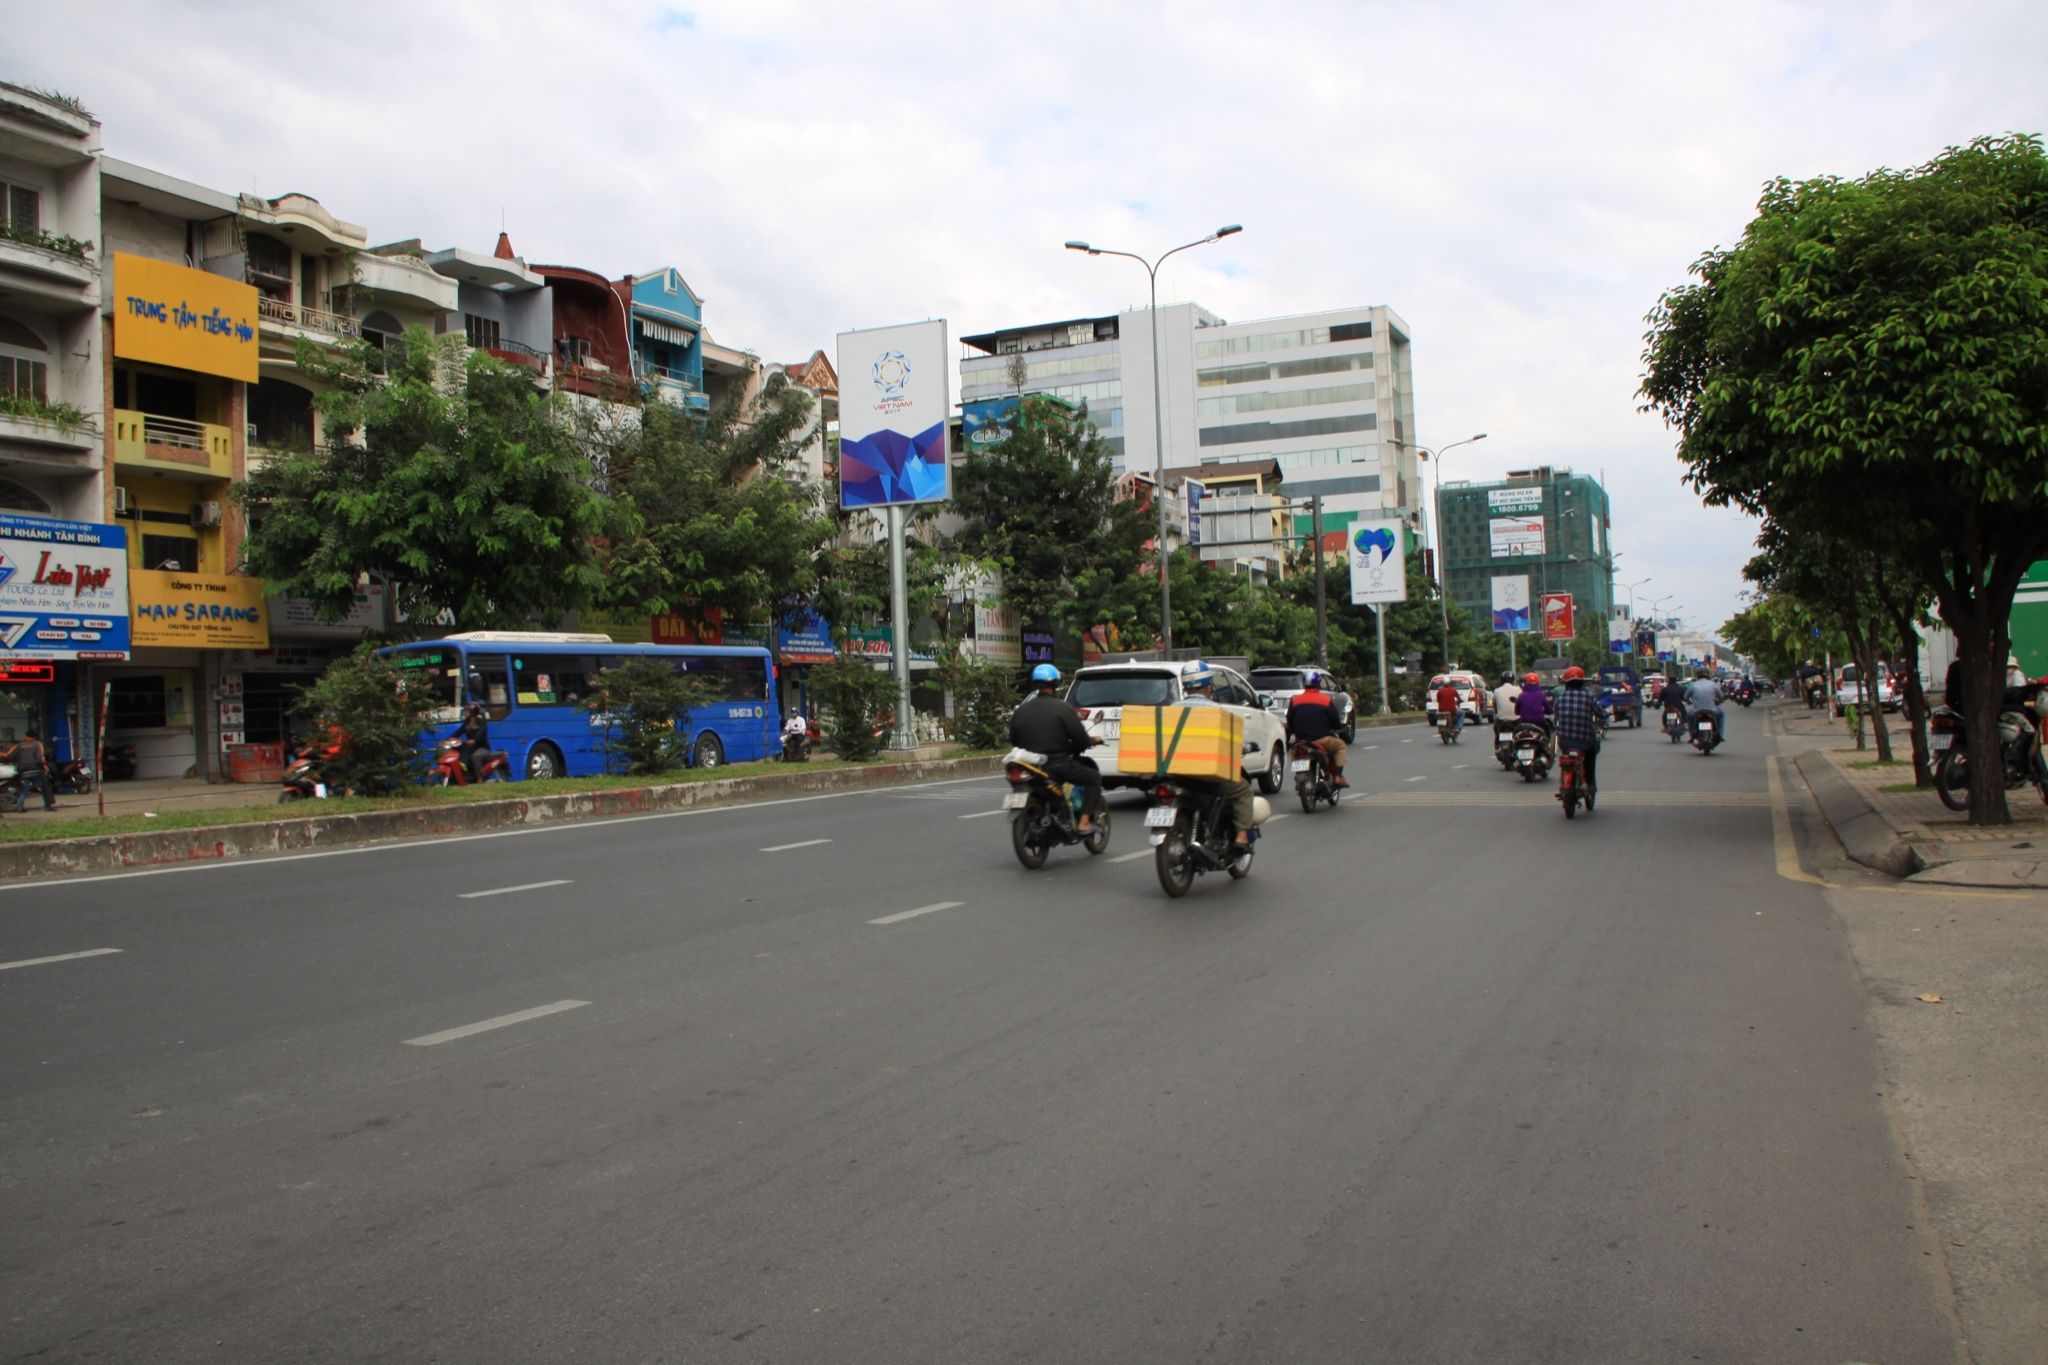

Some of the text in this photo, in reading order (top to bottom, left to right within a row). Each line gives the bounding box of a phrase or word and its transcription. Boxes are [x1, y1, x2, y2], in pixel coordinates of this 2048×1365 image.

[127, 296, 168, 323] TRUNG
[172, 300, 198, 330] TÂM
[201, 307, 232, 336] TIẾNG
[880, 395, 905, 403] APEC
[892, 400, 913, 408] NAM
[1498, 503, 1538, 513] 1800.6799
[14, 526, 52, 540] NHÁNH
[171, 581, 193, 591] CÔNG
[194, 583, 203, 591] TY
[137, 603, 179, 622] HAN
[183, 602, 261, 623] SARANG
